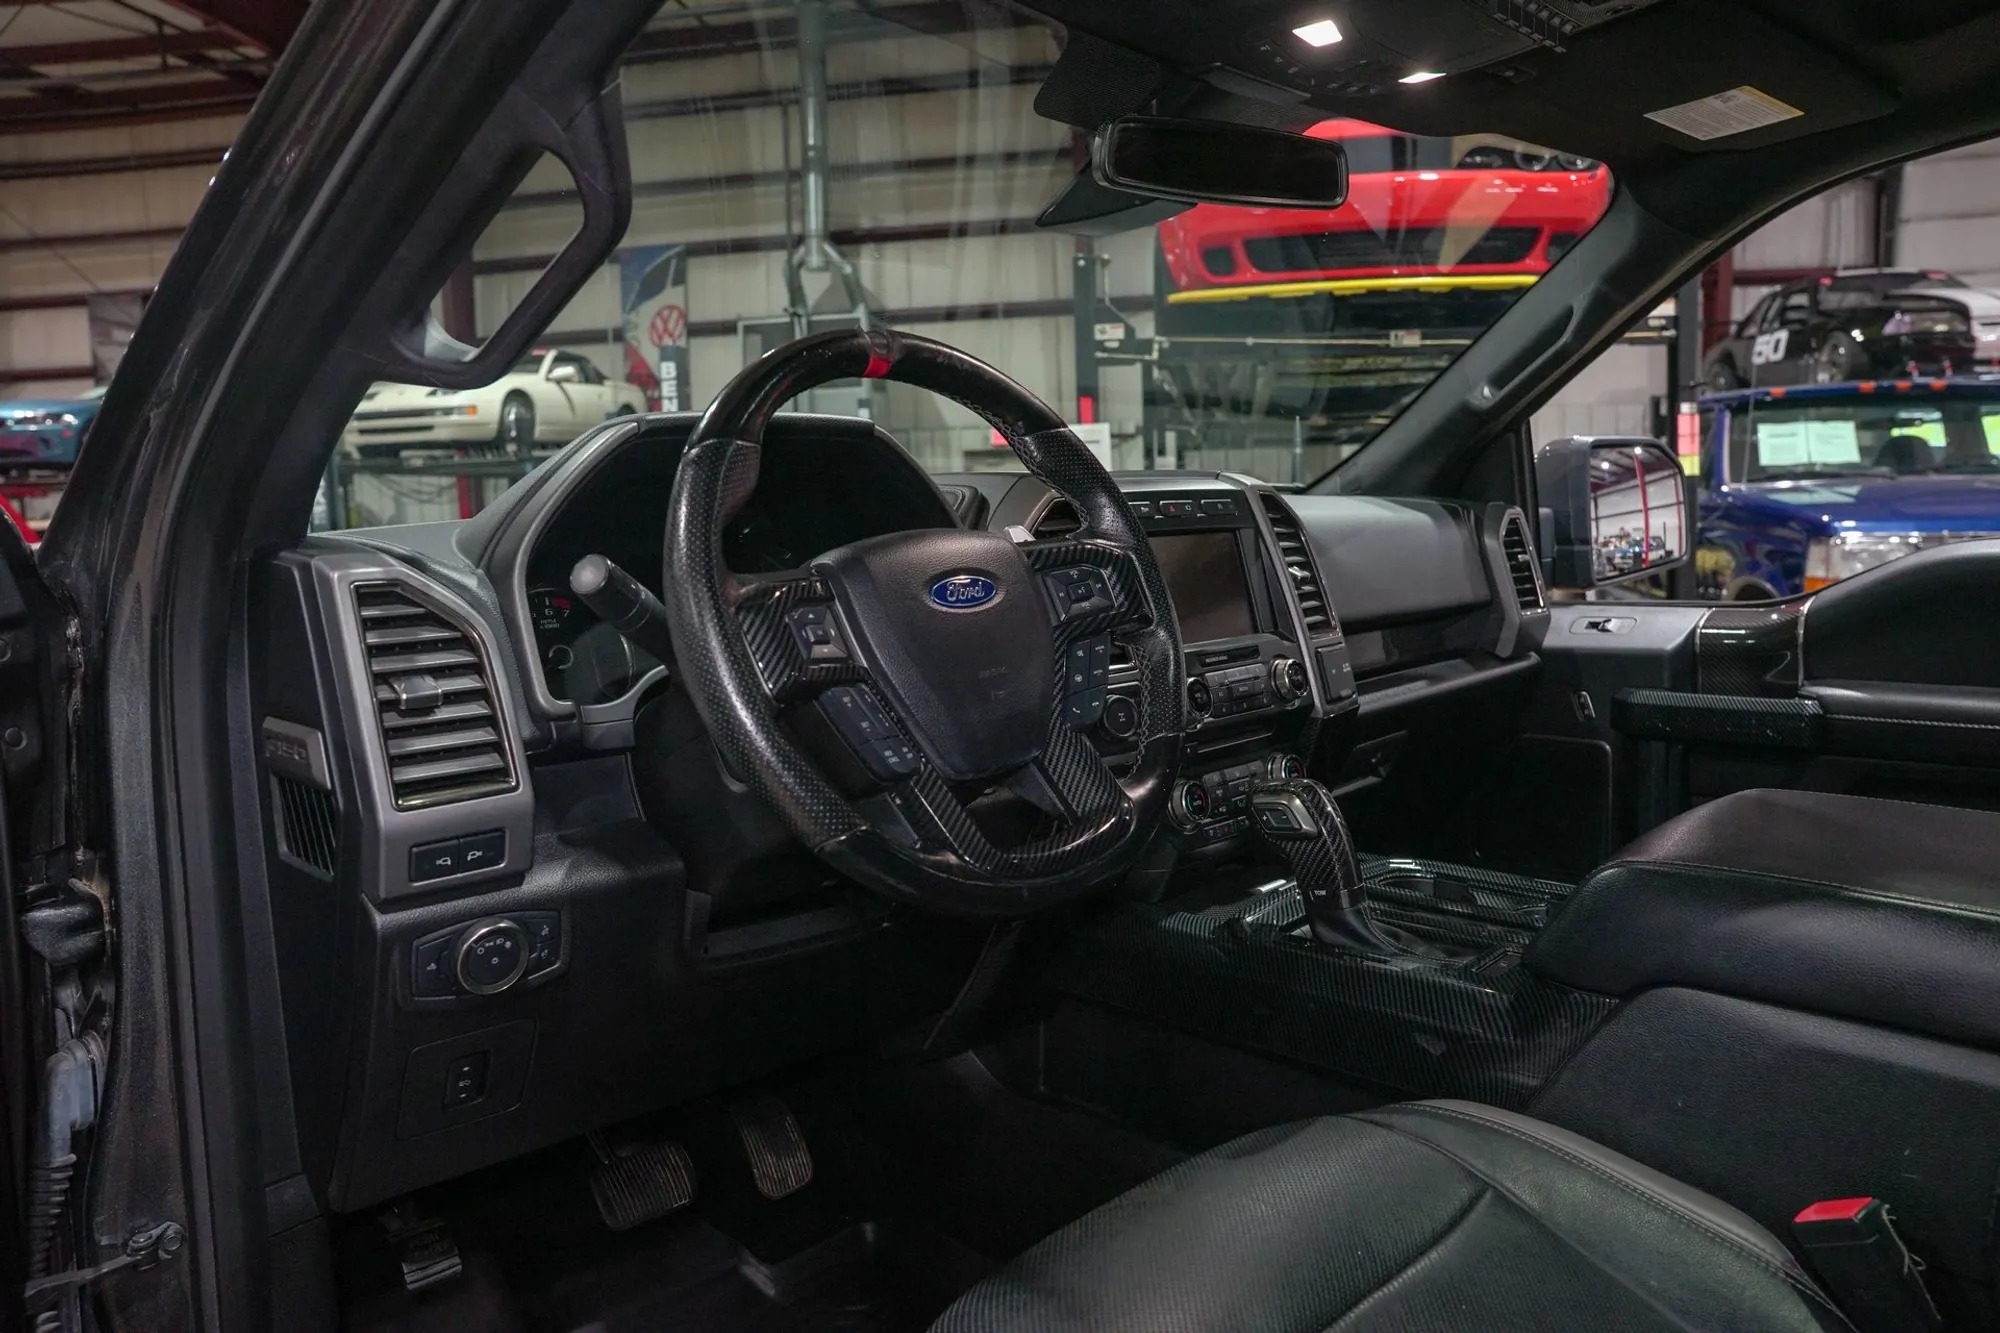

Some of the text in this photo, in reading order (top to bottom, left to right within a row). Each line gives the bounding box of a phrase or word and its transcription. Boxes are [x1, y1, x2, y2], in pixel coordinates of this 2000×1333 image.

[1751, 328, 1790, 366] 50
[660, 361, 679, 412] BEN
[946, 580, 985, 603] Ford
